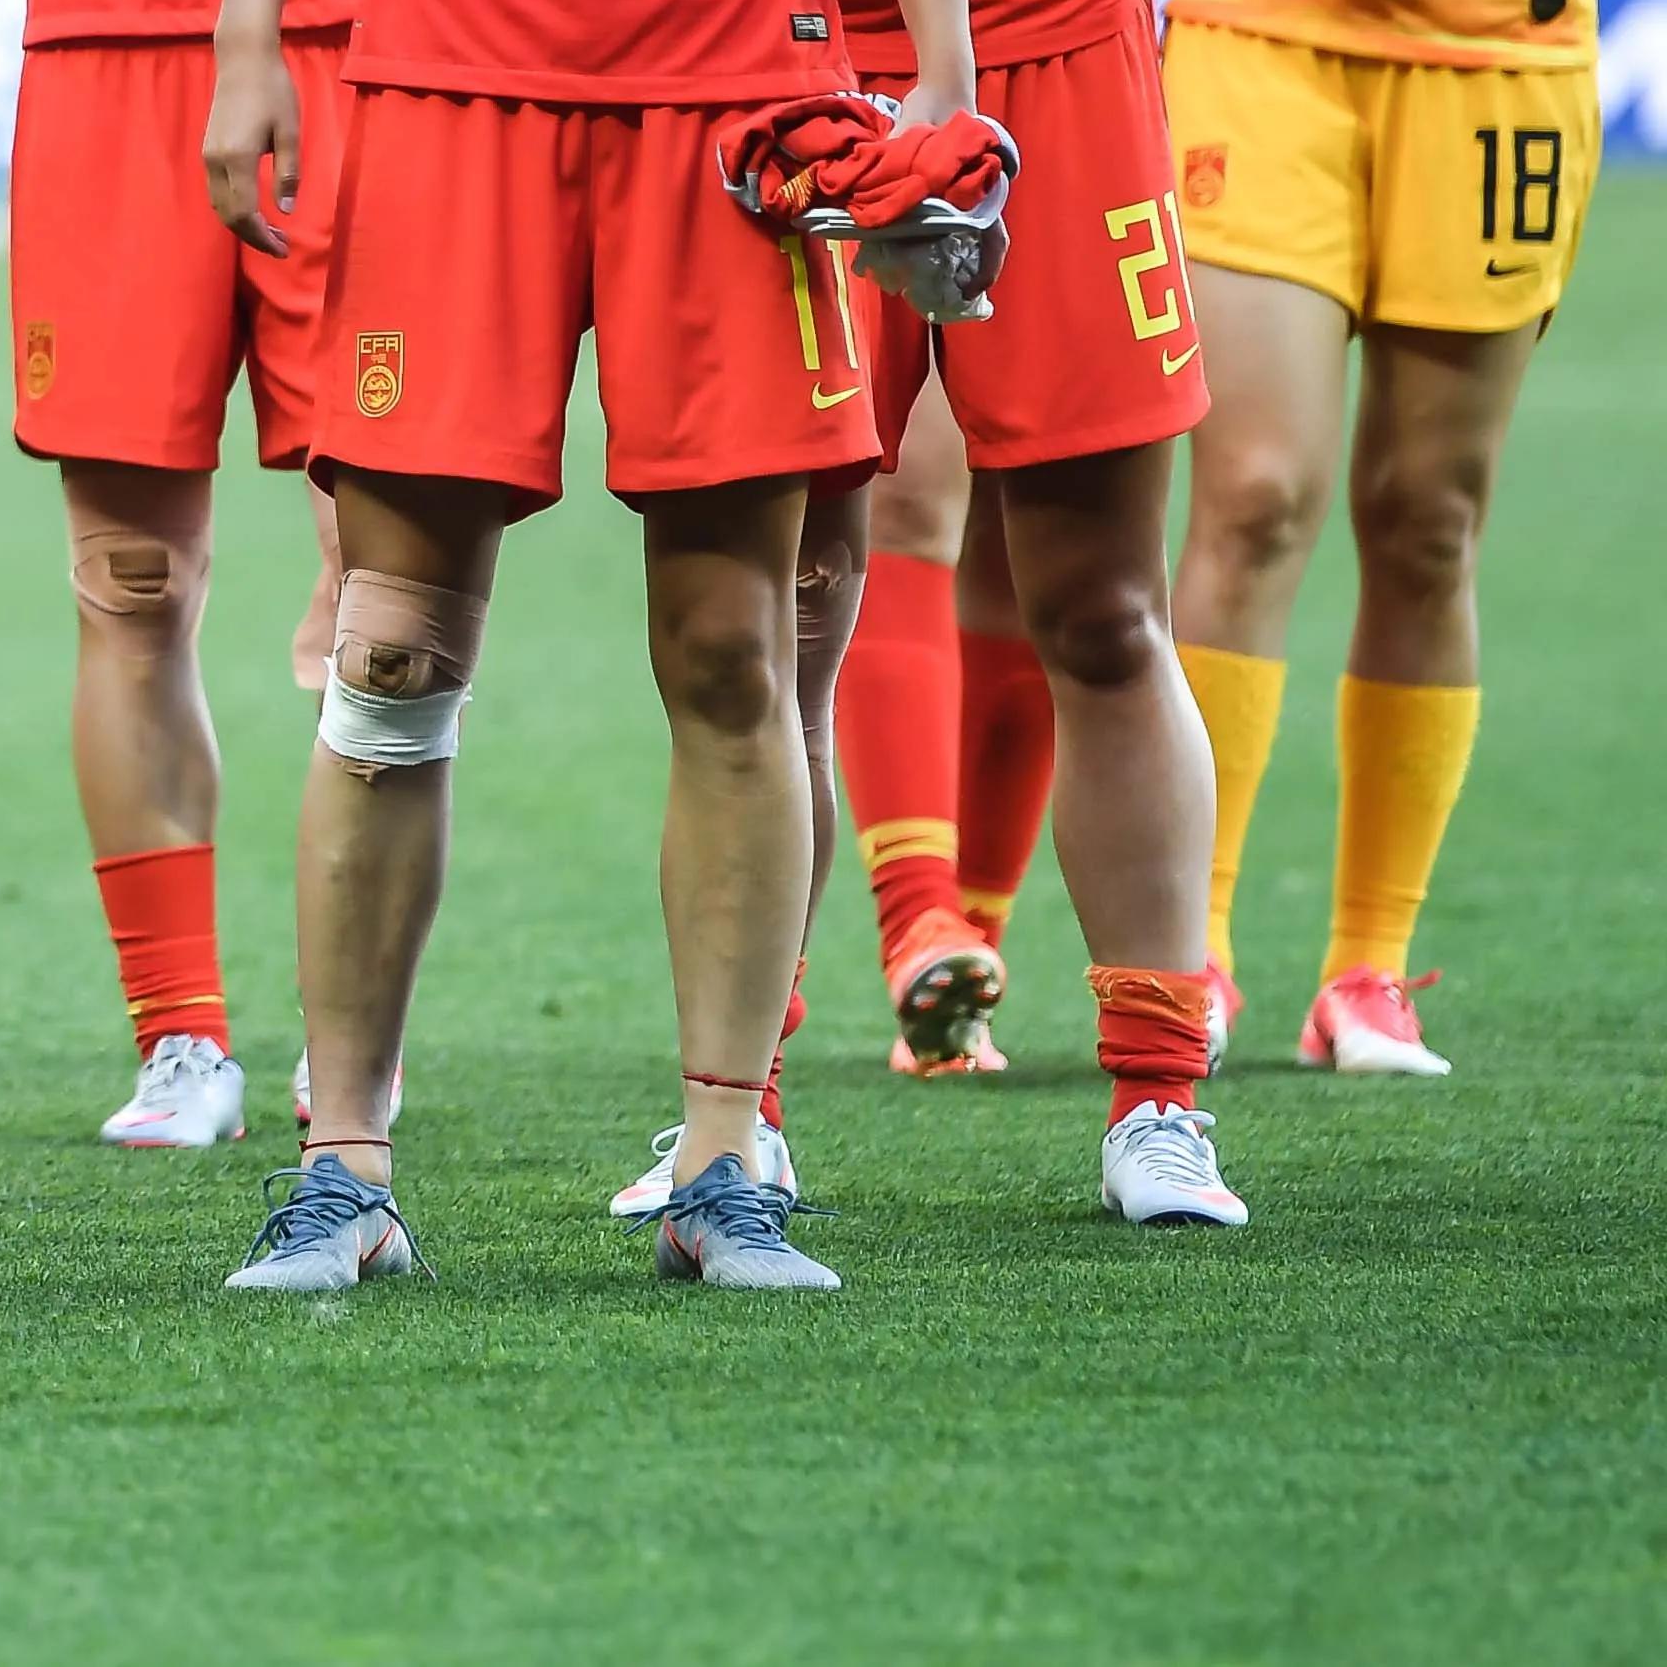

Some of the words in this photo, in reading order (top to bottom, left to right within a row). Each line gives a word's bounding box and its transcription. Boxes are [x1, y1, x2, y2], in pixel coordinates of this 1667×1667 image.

[1474, 128, 1562, 243] 18
[780, 234, 860, 371] 11
[1103, 189, 1197, 341] 21
[360, 337, 399, 354] CFA
